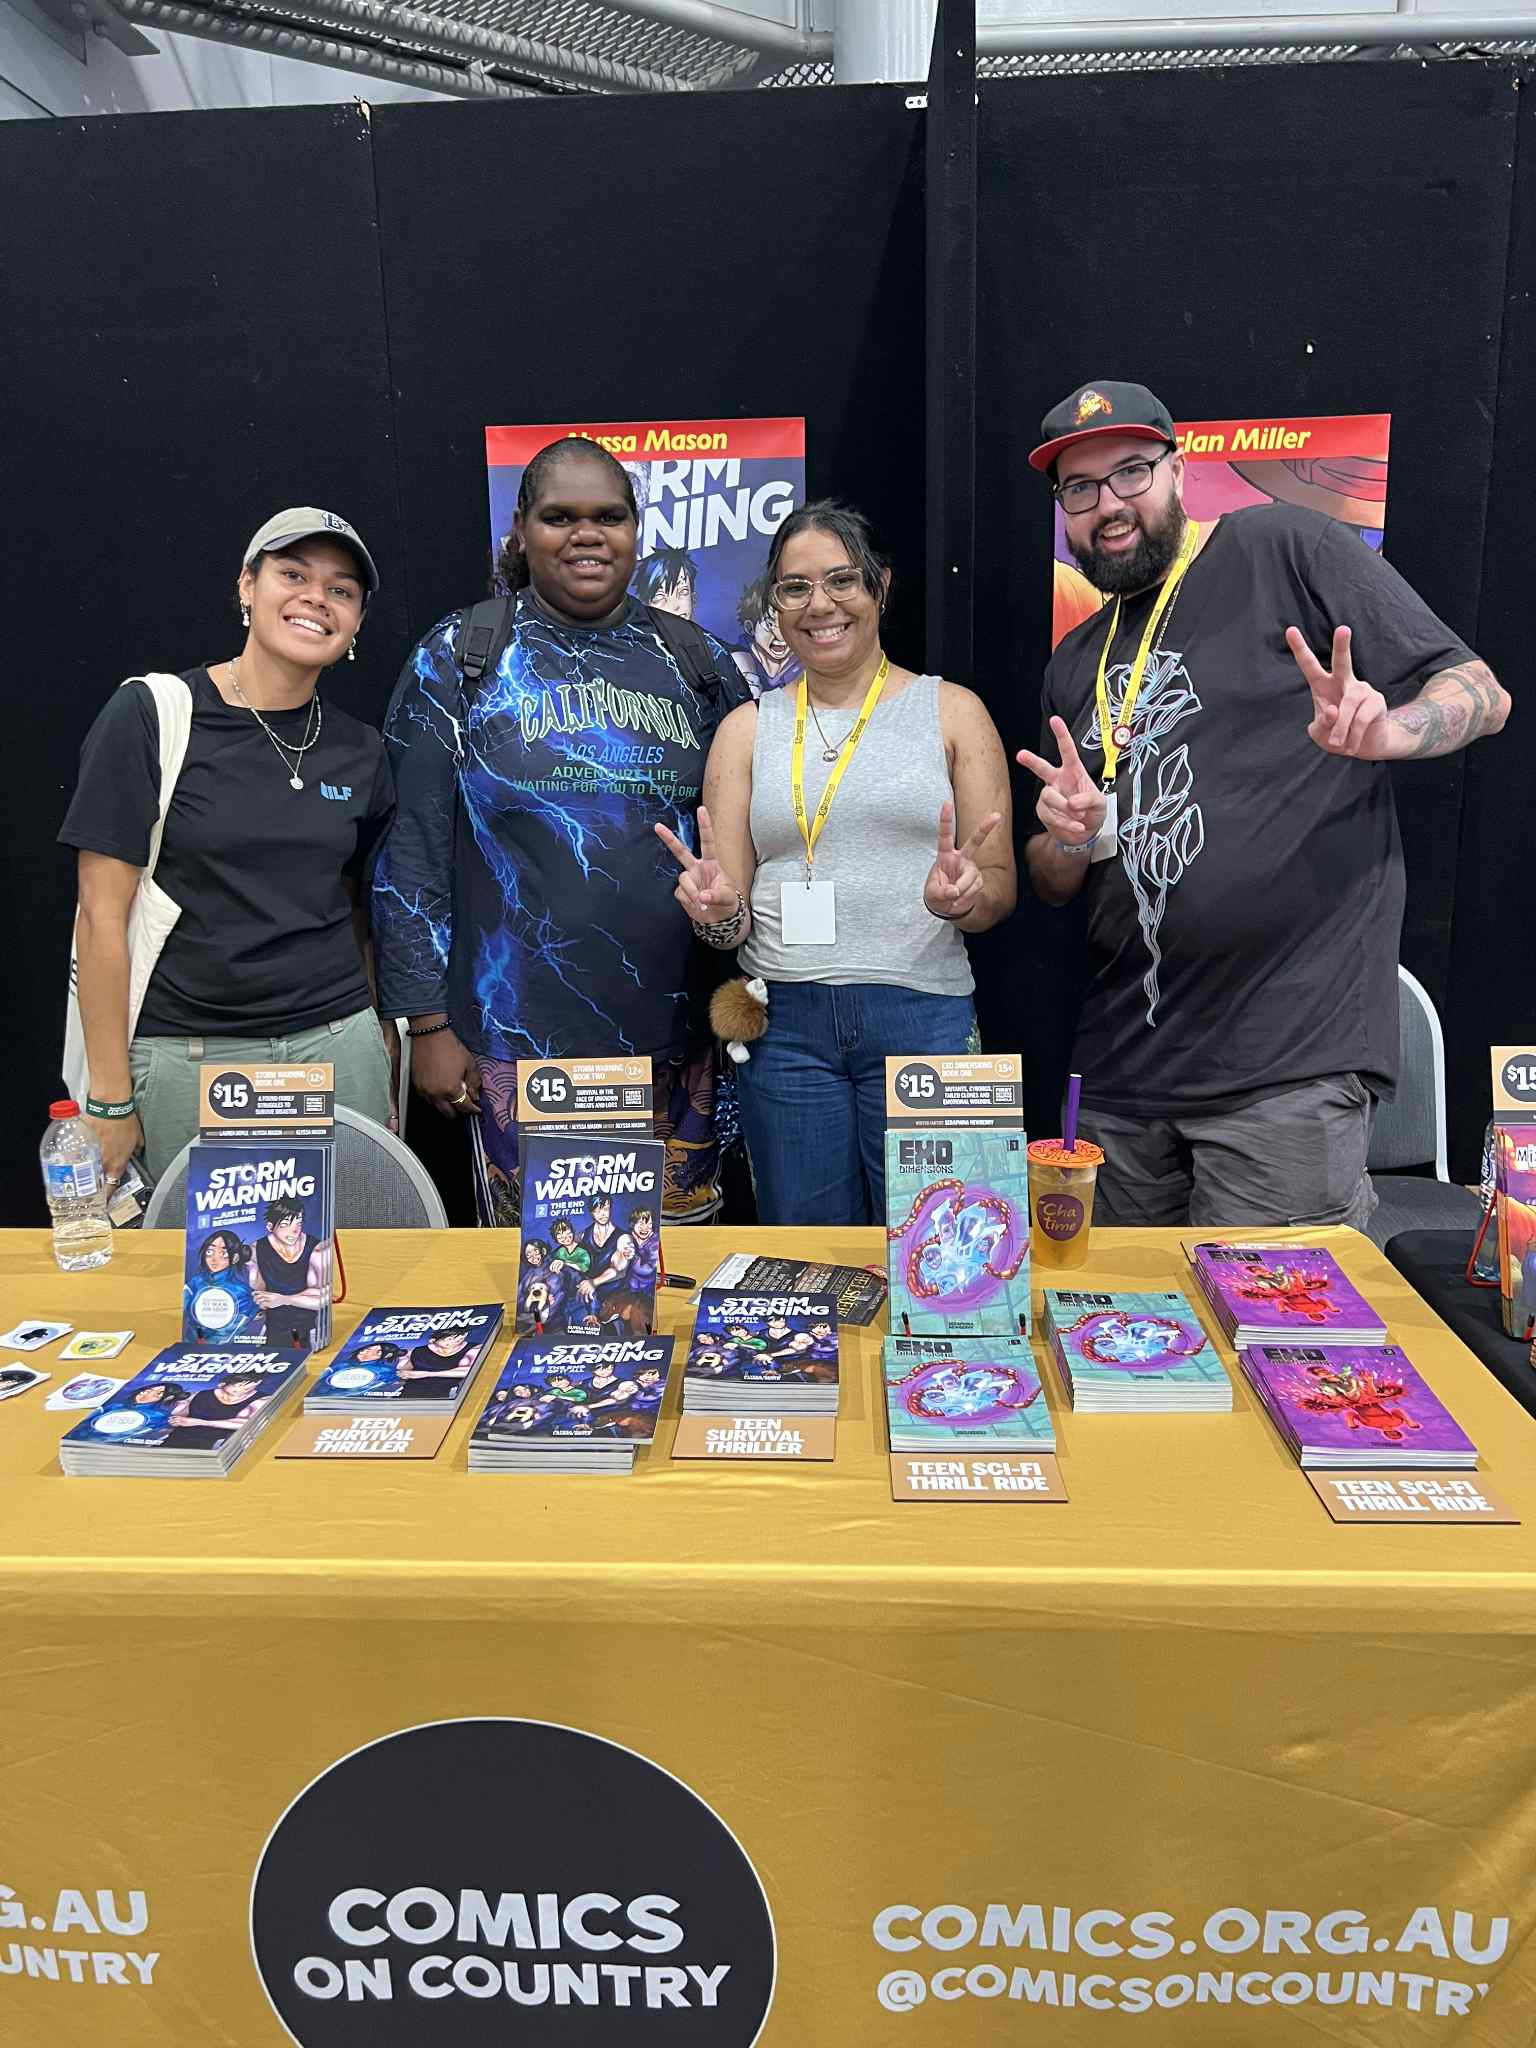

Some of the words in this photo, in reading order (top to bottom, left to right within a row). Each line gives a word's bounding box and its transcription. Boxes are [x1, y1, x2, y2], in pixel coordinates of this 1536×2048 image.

[568, 432, 637, 453] ssa
[644, 429, 728, 452] Mason
[1231, 427, 1312, 451] Miller
[637, 480, 795, 560] NING
[520, 678, 700, 750] CALIFORNIA
[566, 743, 596, 763] LOS
[597, 745, 665, 764] ANGELES
[552, 766, 646, 781] ADVENTURE
[648, 769, 679, 782] LIFE
[514, 779, 569, 793] WAITING
[572, 780, 599, 793] FOR
[604, 781, 626, 795] YOU
[630, 783, 646, 795] TO
[649, 784, 700, 798] EXPLORE
[531, 1077, 567, 1102] $15
[900, 1073, 935, 1098] $15
[213, 1082, 249, 1108] $15
[900, 1140, 953, 1165] EXO
[549, 1152, 636, 1179] STORM
[900, 1165, 953, 1174] DIMENSIONS
[209, 1158, 296, 1190] STORM
[195, 1175, 315, 1212] WARNING
[535, 1171, 655, 1201] WARNING
[568, 1200, 585, 1208] END
[1043, 1203, 1077, 1217] Cha
[551, 1209, 562, 1217] OF
[570, 1208, 584, 1216] ALL
[1043, 1216, 1078, 1231] time
[722, 1297, 810, 1307] STORM
[381, 1309, 474, 1325] STORM
[708, 1306, 830, 1316] WARNING
[364, 1316, 489, 1336] WARNING
[549, 1340, 646, 1356] STORM
[177, 1352, 280, 1364] STORM
[534, 1350, 664, 1365] WARNING
[154, 1362, 292, 1374] WARNING
[351, 1417, 401, 1429] TEEN
[733, 1418, 782, 1430] TEEN
[317, 1429, 414, 1441] SURVIVAL
[705, 1429, 804, 1442] SURVIVAL
[313, 1440, 409, 1453] THRILLER
[705, 1441, 802, 1455] THRILLER
[907, 1461, 965, 1475] TEEN
[972, 1461, 1042, 1475] SCI-FI
[907, 1476, 988, 1490] THRILL
[994, 1476, 1049, 1491] RIDE
[1329, 1480, 1399, 1495] TEEN
[1398, 1480, 1479, 1495] SCI-FI
[1338, 1495, 1430, 1511] THRILL
[1428, 1495, 1495, 1511] RIDE
[328, 1886, 684, 1955] COMICS
[872, 1903, 1510, 1966] COMICS.ORG.AU
[293, 1956, 393, 2002] ON
[408, 1954, 731, 2010] COUNTRY
